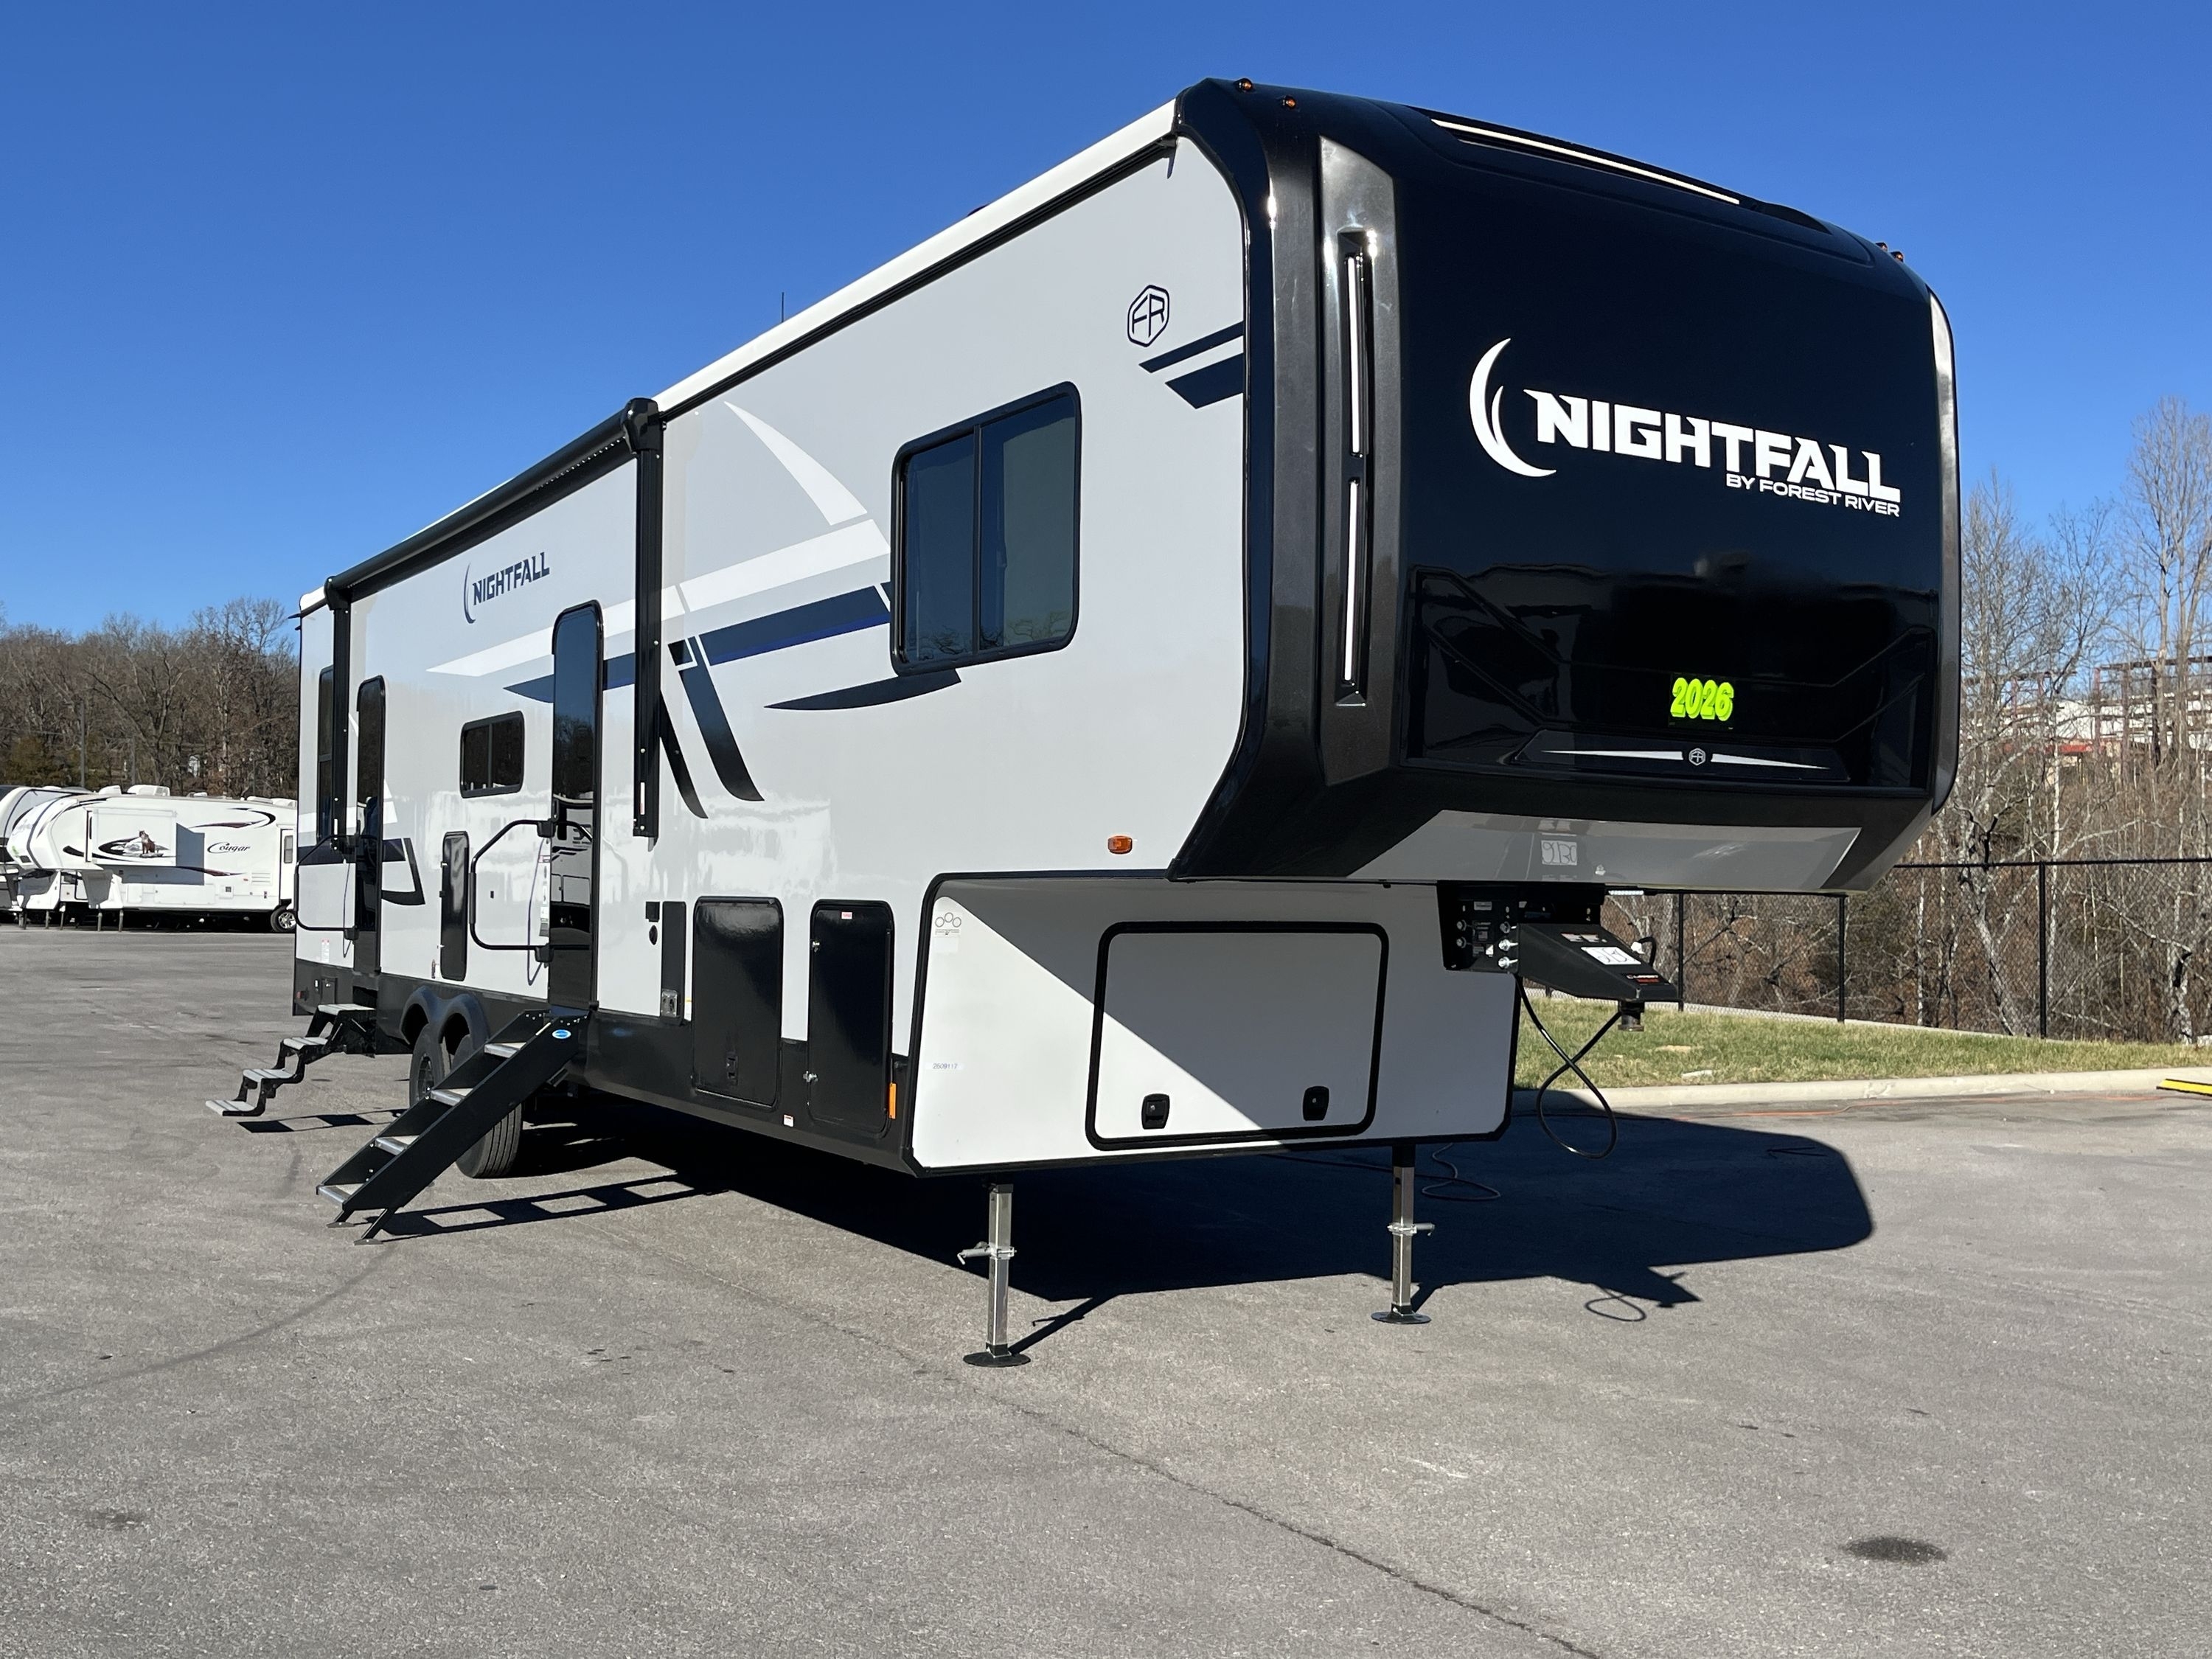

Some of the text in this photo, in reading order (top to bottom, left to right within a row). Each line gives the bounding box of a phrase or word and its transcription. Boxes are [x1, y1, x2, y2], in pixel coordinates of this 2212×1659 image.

[1523, 389, 1900, 503] NIGHTFALL
[1726, 473, 1900, 517] BY FOREST RIVER
[472, 552, 550, 605] NIGHTFALL
[1670, 677, 1734, 722] 2026
[207, 841, 251, 854] Cougar
